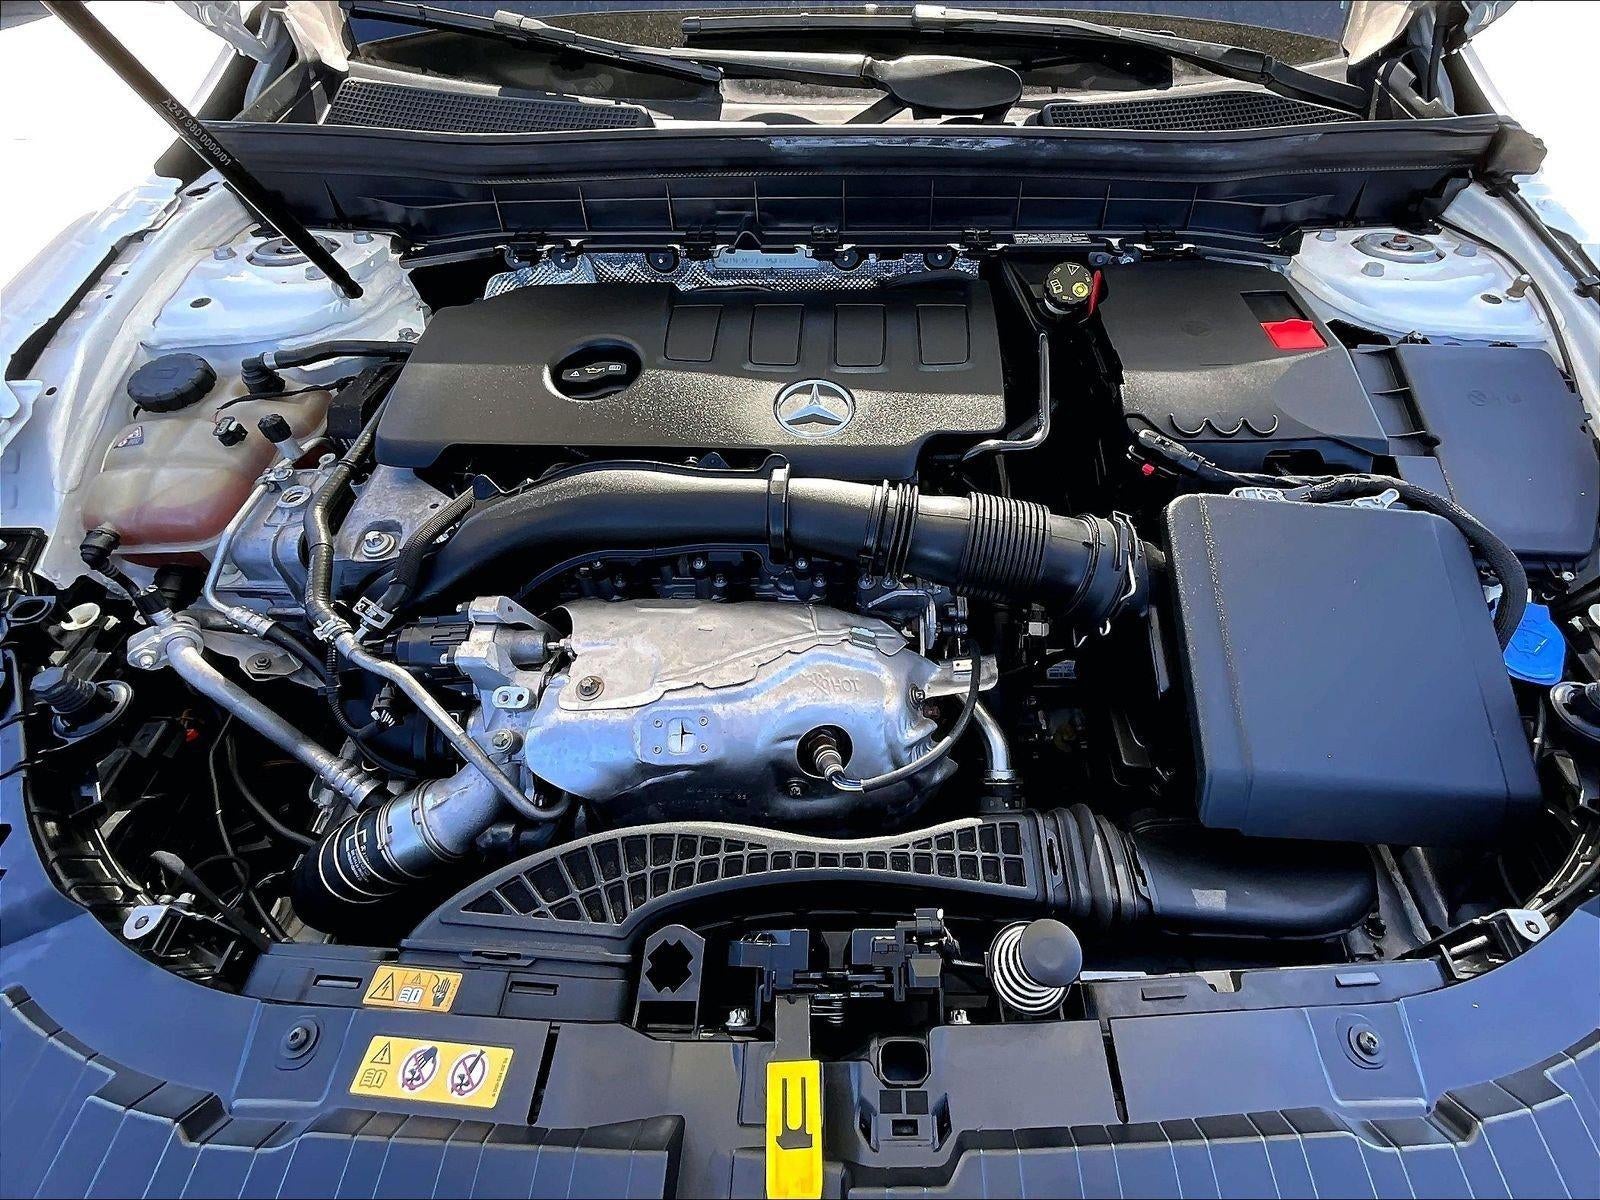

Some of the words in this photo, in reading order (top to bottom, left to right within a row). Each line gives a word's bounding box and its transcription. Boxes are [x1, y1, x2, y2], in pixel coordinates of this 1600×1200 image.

[162, 98, 188, 120] A247
[184, 119, 202, 137] 980
[199, 133, 233, 166] 0000/01
[830, 676, 859, 693] HOT
